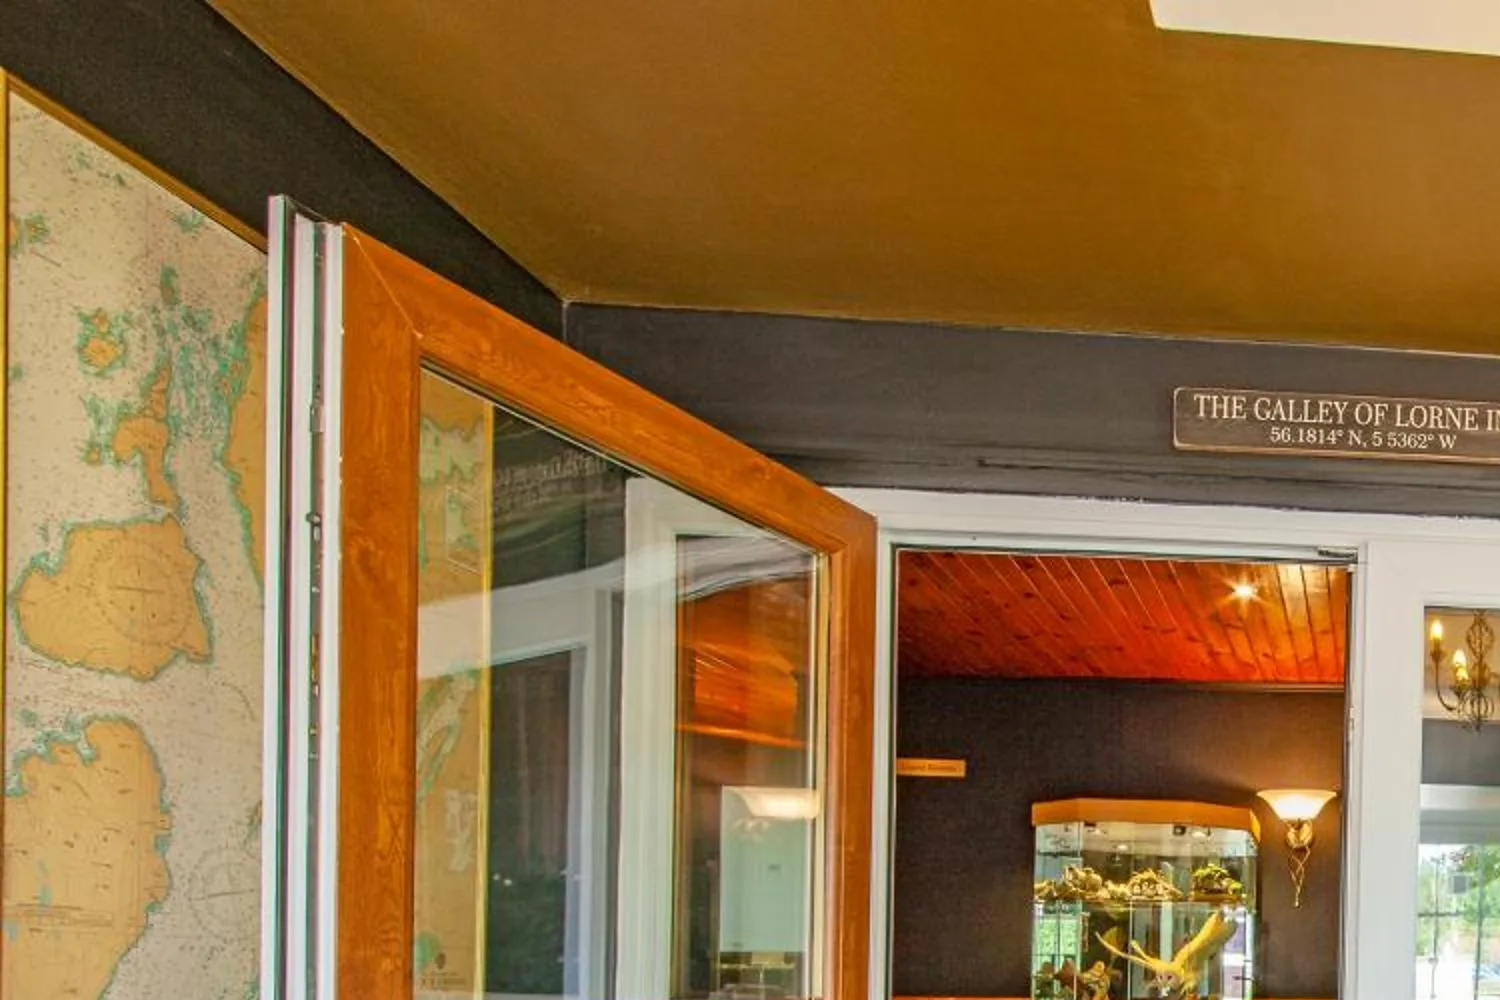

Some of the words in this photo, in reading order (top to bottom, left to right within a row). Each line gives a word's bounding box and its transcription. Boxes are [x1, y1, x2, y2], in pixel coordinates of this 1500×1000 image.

[1193, 394, 1247, 419] THE
[1254, 397, 1348, 425] GALLEY
[1354, 402, 1389, 427] OF
[1395, 404, 1480, 431] LORNE
[1438, 434, 1457, 449] W
